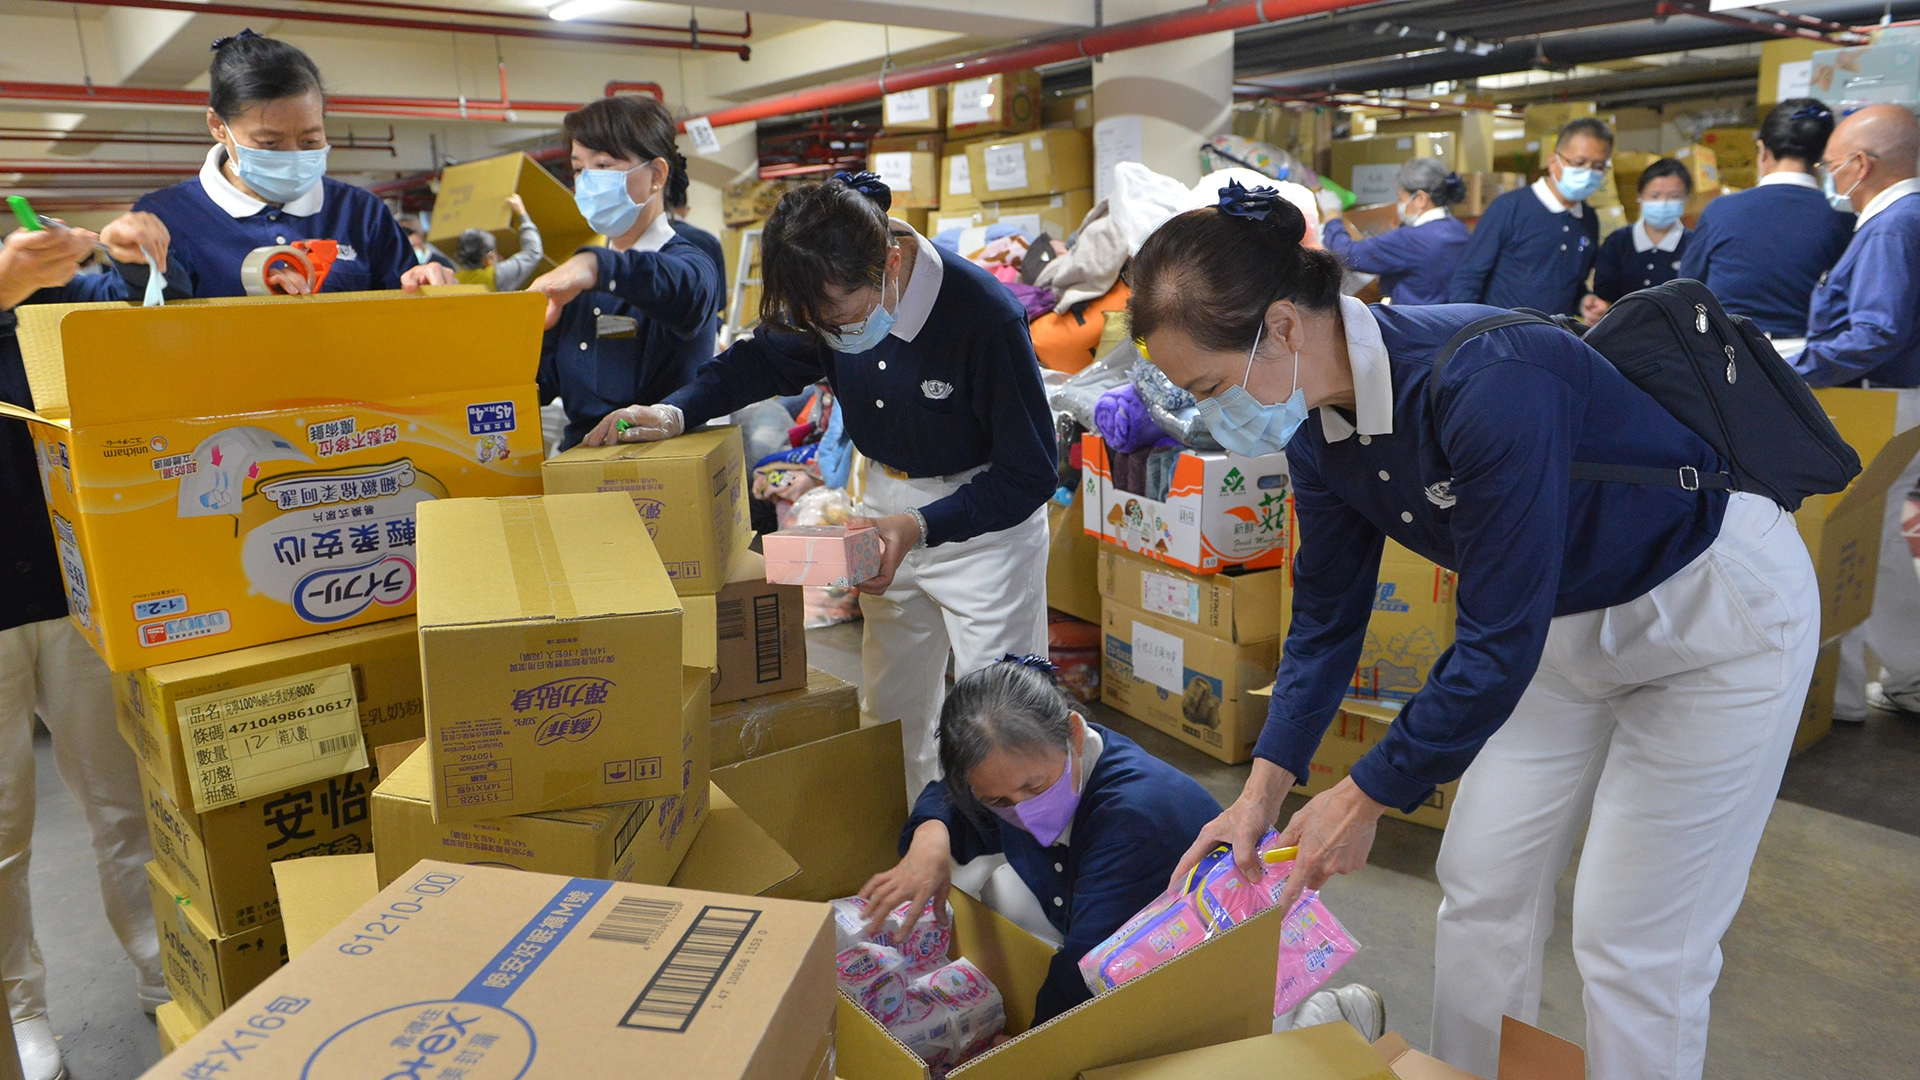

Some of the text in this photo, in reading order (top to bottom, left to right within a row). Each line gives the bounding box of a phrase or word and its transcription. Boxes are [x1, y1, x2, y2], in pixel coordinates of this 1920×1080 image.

[104, 446, 148, 458] unicharm
[154, 454, 191, 469] 立體側邊
[163, 462, 197, 479] 超防漏
[279, 477, 397, 507] 細緻棉柔呵護
[313, 505, 374, 522] 易換式尿片
[1234, 522, 1255, 535] 新鮮
[273, 517, 416, 565] 輕柔安心
[308, 568, 404, 604] ライフリー
[510, 681, 609, 713] 彈力貼身
[190, 704, 221, 725] 品名
[229, 698, 352, 734] 4710498610617
[193, 724, 224, 745] 條碼
[278, 726, 309, 746] 箱入數
[547, 716, 595, 738] 蘇菲
[196, 745, 229, 765] 數量
[244, 735, 269, 759] 12
[460, 752, 494, 761] 150762
[201, 765, 233, 786] 初盤
[205, 784, 237, 804] 抽盤
[460, 793, 499, 804] 131528
[263, 779, 368, 850] 安怡
[338, 874, 456, 956] 61210-00
[482, 890, 594, 988] 晚安好眠褲M號
